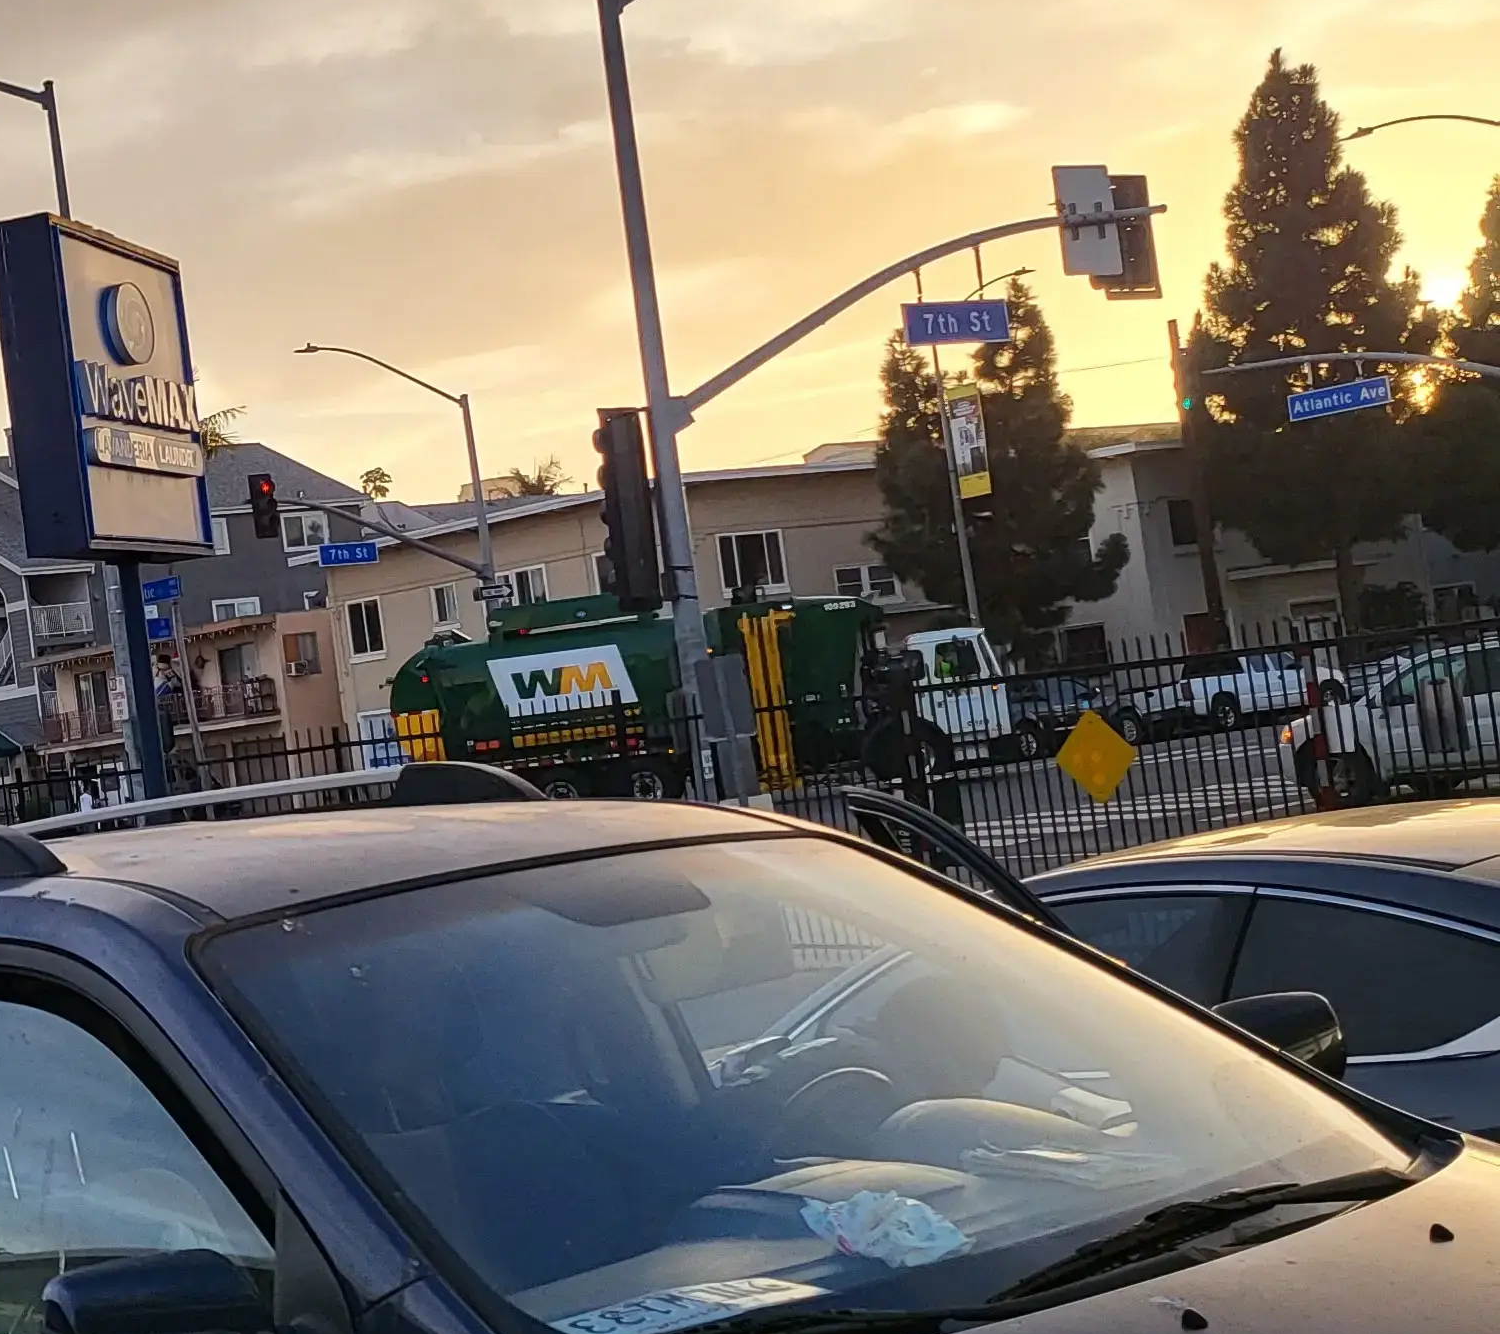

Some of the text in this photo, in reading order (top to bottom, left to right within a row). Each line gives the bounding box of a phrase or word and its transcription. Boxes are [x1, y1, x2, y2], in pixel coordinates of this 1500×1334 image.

[923, 310, 992, 335] 7th St
[74, 359, 200, 433] WaveMAX
[1293, 386, 1386, 415] Atlantic Ave
[329, 546, 369, 560] 7th St
[510, 661, 613, 699] WM
